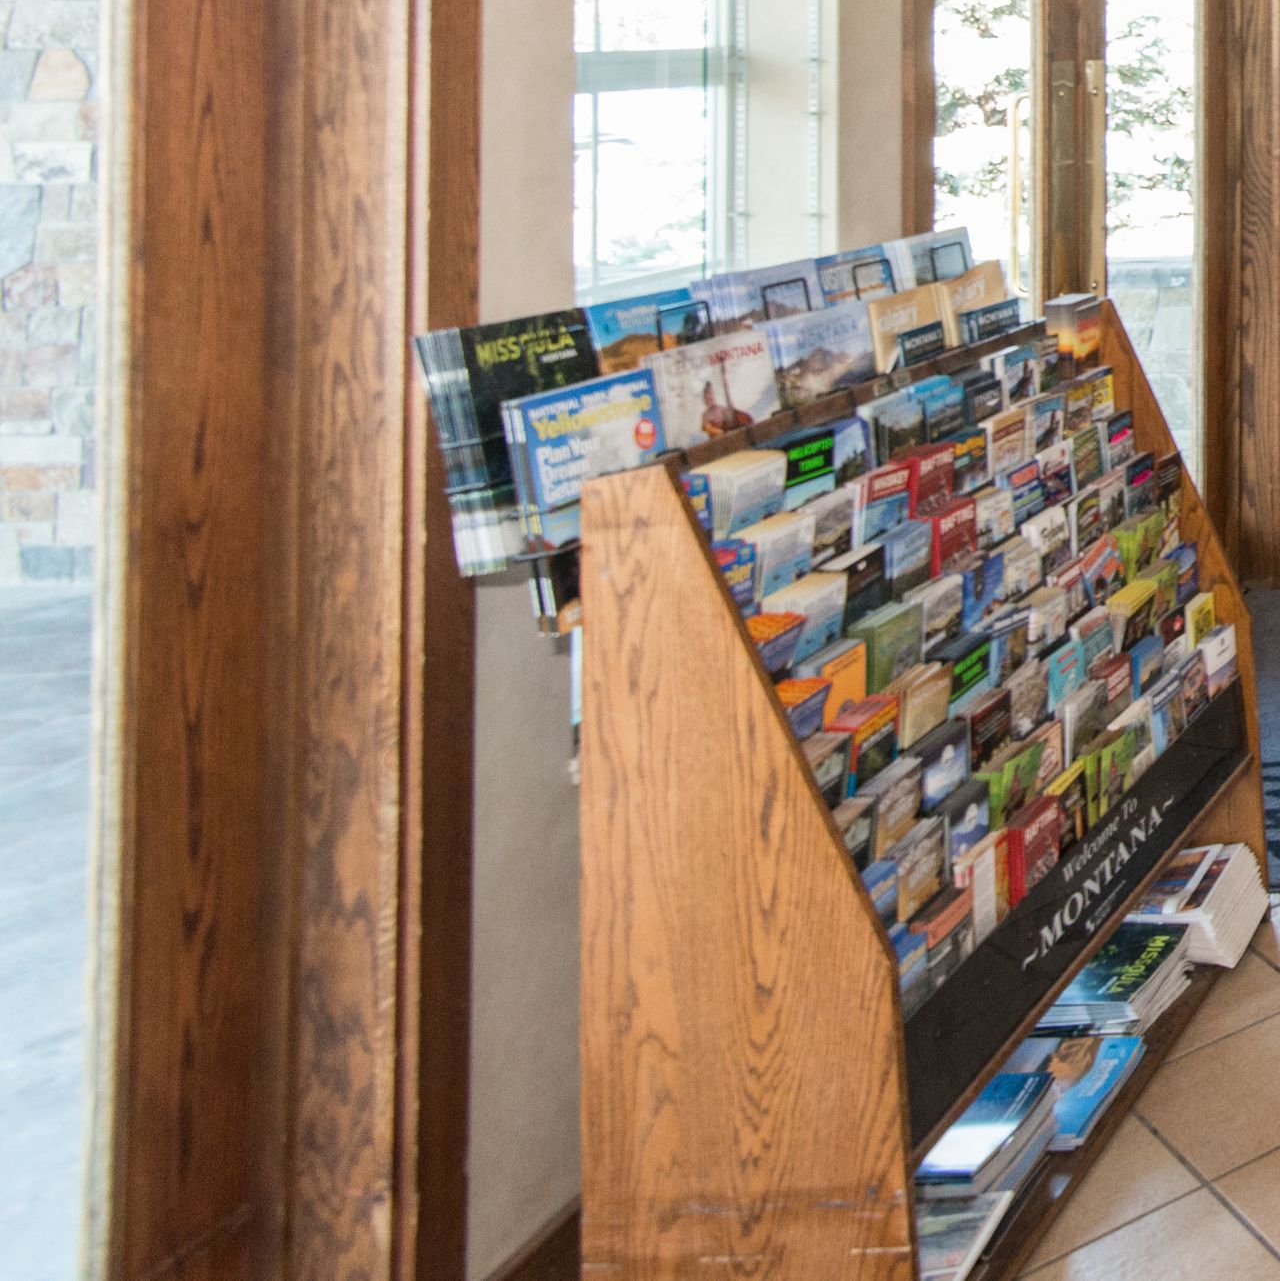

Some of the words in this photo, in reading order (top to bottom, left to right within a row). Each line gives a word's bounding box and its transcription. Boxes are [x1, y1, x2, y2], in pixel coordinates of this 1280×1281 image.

[709, 340, 765, 367] MONTANA
[531, 394, 653, 442] Yellowstone
[536, 441, 570, 467] Plan
[1062, 813, 1123, 884] Welcome
[1121, 796, 1138, 819] To
[1108, 932, 1171, 996] MISSOULA
